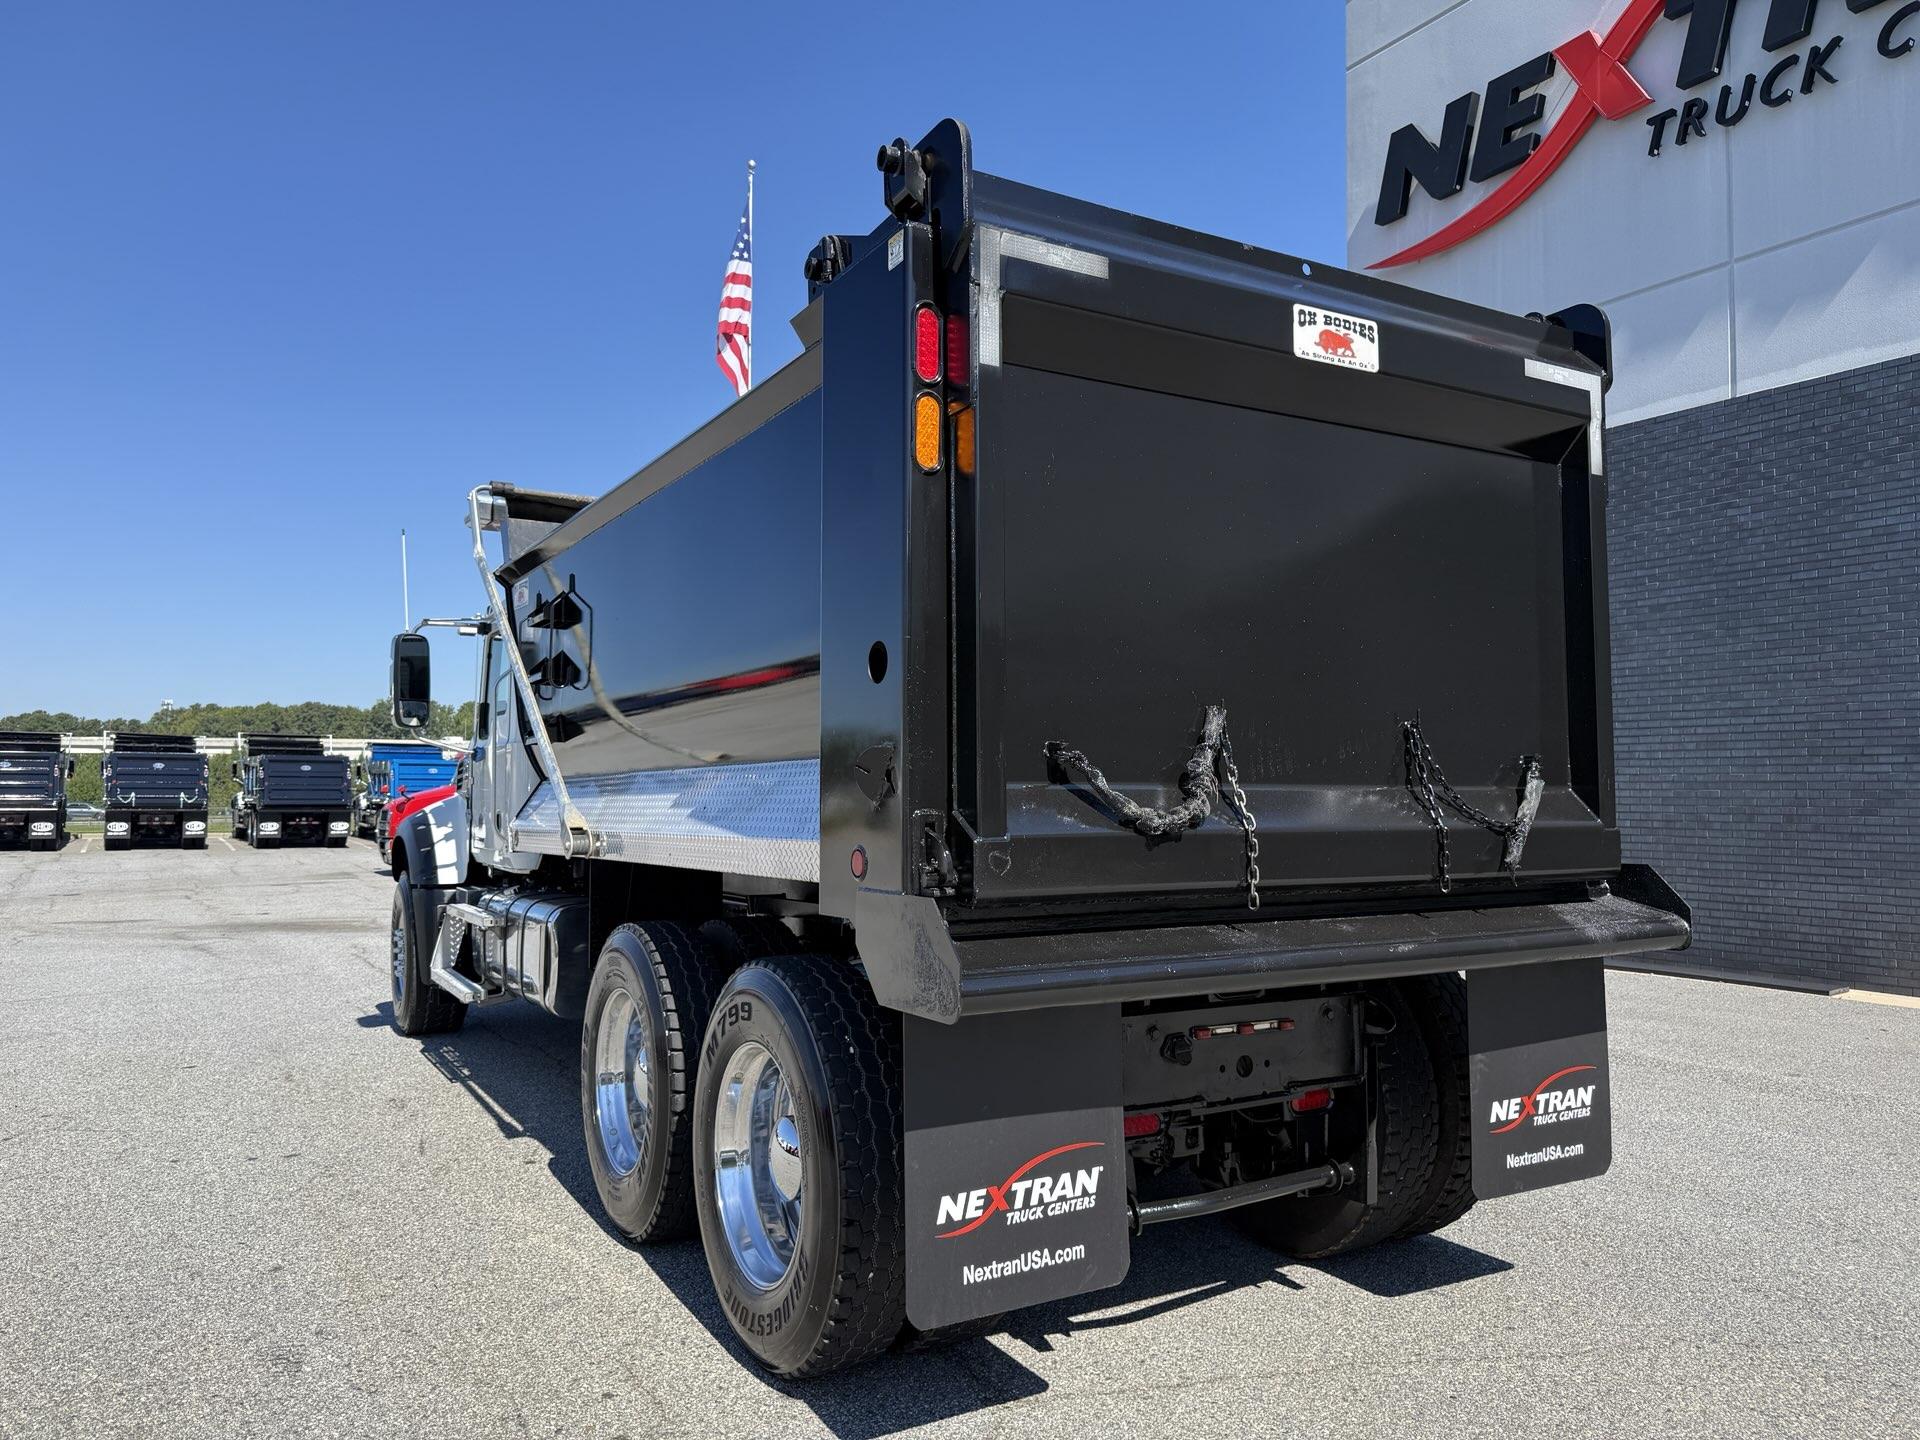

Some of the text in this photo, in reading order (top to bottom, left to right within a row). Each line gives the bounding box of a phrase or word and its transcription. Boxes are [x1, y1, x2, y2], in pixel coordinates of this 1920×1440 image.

[1646, 35, 1844, 157] TRUCK
[1298, 309, 1375, 344] OX BODIES
[1313, 352, 1335, 362] Strong
[705, 1001, 753, 1070] M799
[1489, 1084, 1596, 1124] NEXTRAN
[1533, 1106, 1591, 1126] TRUCK CENTERS
[1506, 1143, 1584, 1169] NextranUSA.com
[936, 1164, 1104, 1226] NEXTRAN
[1006, 1195, 1097, 1226] TRUCK CENTERS
[963, 1244, 1085, 1286] NextranUSA.com
[723, 1245, 808, 1337] BRIDGESTONE
